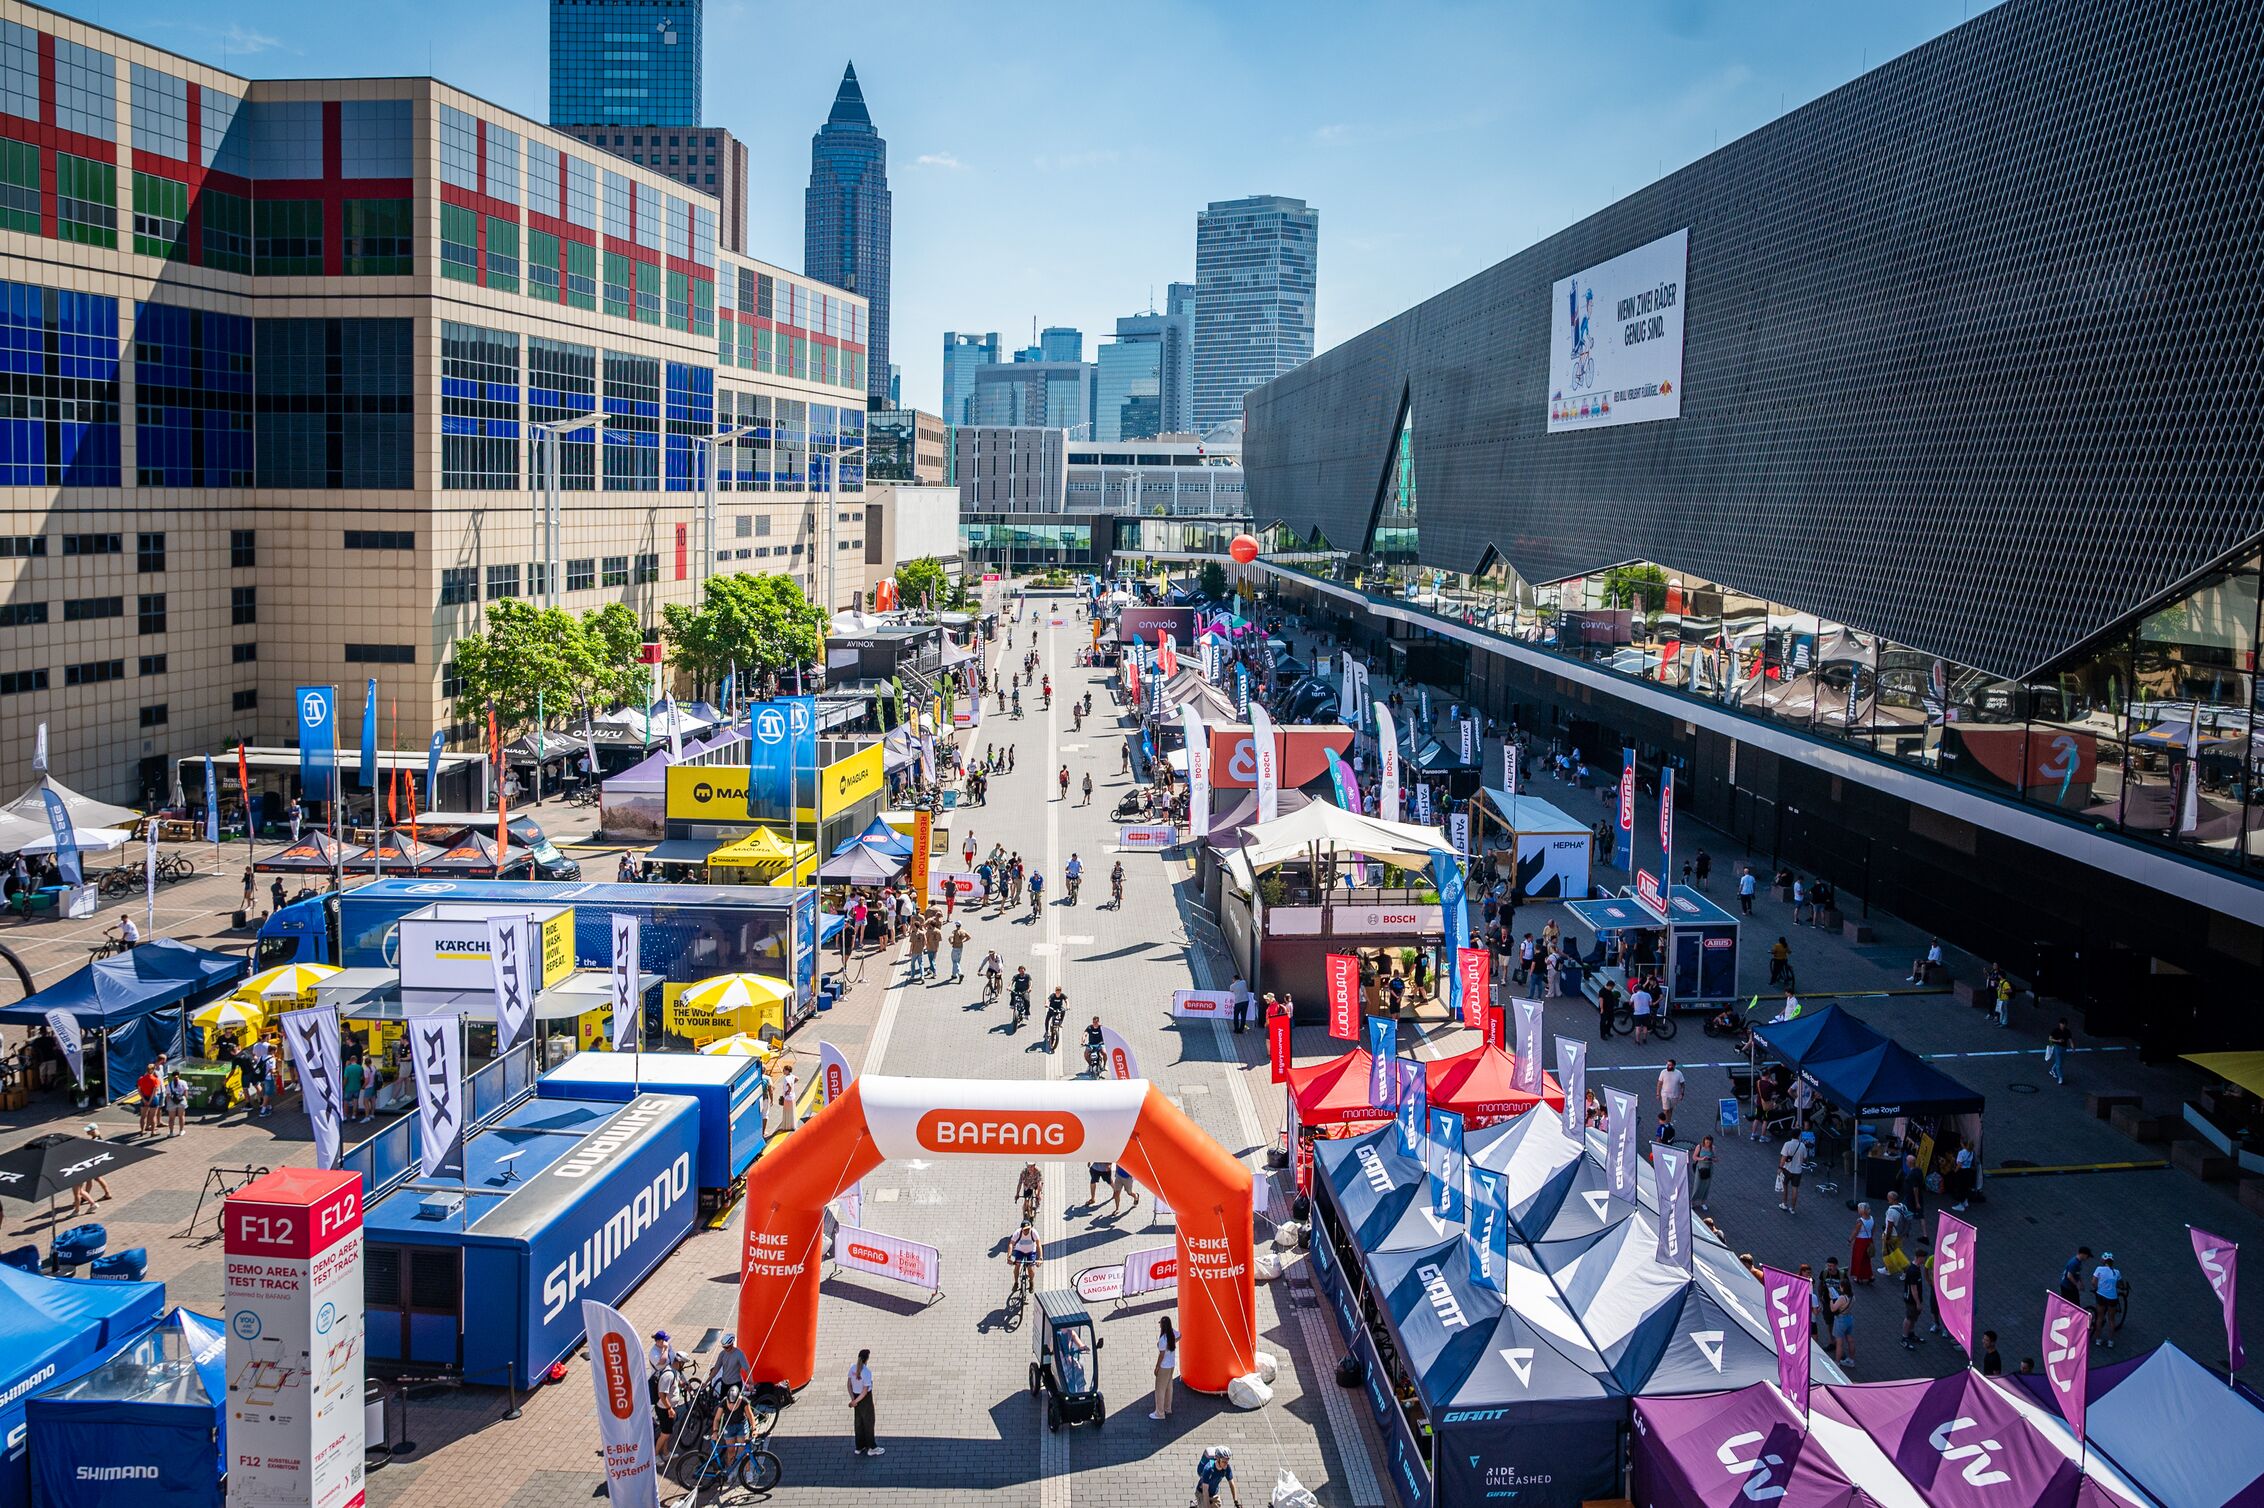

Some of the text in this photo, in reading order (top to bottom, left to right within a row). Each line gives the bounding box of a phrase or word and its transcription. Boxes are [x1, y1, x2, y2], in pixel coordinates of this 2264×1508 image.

[1617, 281, 1677, 322] WENN ZWEI RÄDER
[1624, 315, 1665, 346] GENUG SIND.
[675, 527, 686, 547] 10
[1138, 619, 1177, 629] enviolo
[846, 640, 875, 648] AVINOX
[846, 768, 869, 786] MAGURA
[917, 816, 927, 877] REGISTRATION
[1553, 841, 1581, 850] HEPHA
[1382, 914, 1416, 924] BOSCH
[546, 922, 558, 936] RIDE.
[435, 939, 491, 952] KÄRCHE
[546, 933, 562, 948] WASH.
[546, 947, 561, 961] WOW.
[546, 956, 566, 974] REPEAT.
[583, 959, 597, 967] the
[673, 1009, 716, 1017] THE WOW
[673, 1018, 734, 1027] TO YOUR BIKE.
[1478, 1102, 1532, 1112] momentum
[1880, 1106, 1900, 1114] Royal
[553, 1098, 668, 1178] SHIMANO
[937, 1121, 1064, 1146] BAFANG
[59, 1152, 115, 1178] XTR
[1355, 1144, 1396, 1193] GIANT
[321, 1193, 355, 1237] F12
[241, 1215, 294, 1245] F12
[543, 1151, 690, 1327] SHIMANO
[750, 1231, 789, 1246] E-BIKE
[1188, 1236, 1229, 1249] E-BIKE
[313, 1255, 336, 1275] DEMO
[338, 1239, 359, 1261] AREA
[749, 1246, 786, 1261] DRIVE
[852, 1246, 884, 1261] BAFANG
[1189, 1252, 1228, 1264] DRIVE
[228, 1263, 262, 1276] DEMO
[266, 1266, 298, 1278] AREA
[313, 1251, 359, 1287] TEST TRACK
[748, 1261, 805, 1277] SYSTEMS
[1156, 1263, 1178, 1275] BAF
[1189, 1264, 1245, 1280] SYSTEMS
[228, 1276, 299, 1291] TEST TRACK
[1083, 1274, 1106, 1284] SLOW
[228, 1291, 291, 1301] powered by BAFANG
[1083, 1284, 1119, 1295] LANGSAM
[1416, 1263, 1469, 1329] GIANT
[607, 1343, 628, 1409] BAFANG
[0, 1363, 55, 1407] SHIMANO
[1443, 1408, 1510, 1423] GIANT
[314, 1434, 347, 1463] TEST TRACK
[606, 1443, 638, 1455] E-Bike
[239, 1455, 261, 1467] F12
[267, 1457, 301, 1465] AUSSTELLER
[267, 1463, 300, 1471] EXHIBITORS
[607, 1456, 636, 1467] Drive
[76, 1465, 159, 1481] SHIMANO
[610, 1461, 652, 1480] Systems
[1486, 1466, 1515, 1477] RIDE
[1402, 1459, 1420, 1500] GIANT
[1485, 1475, 1552, 1486] UNLEASHED
